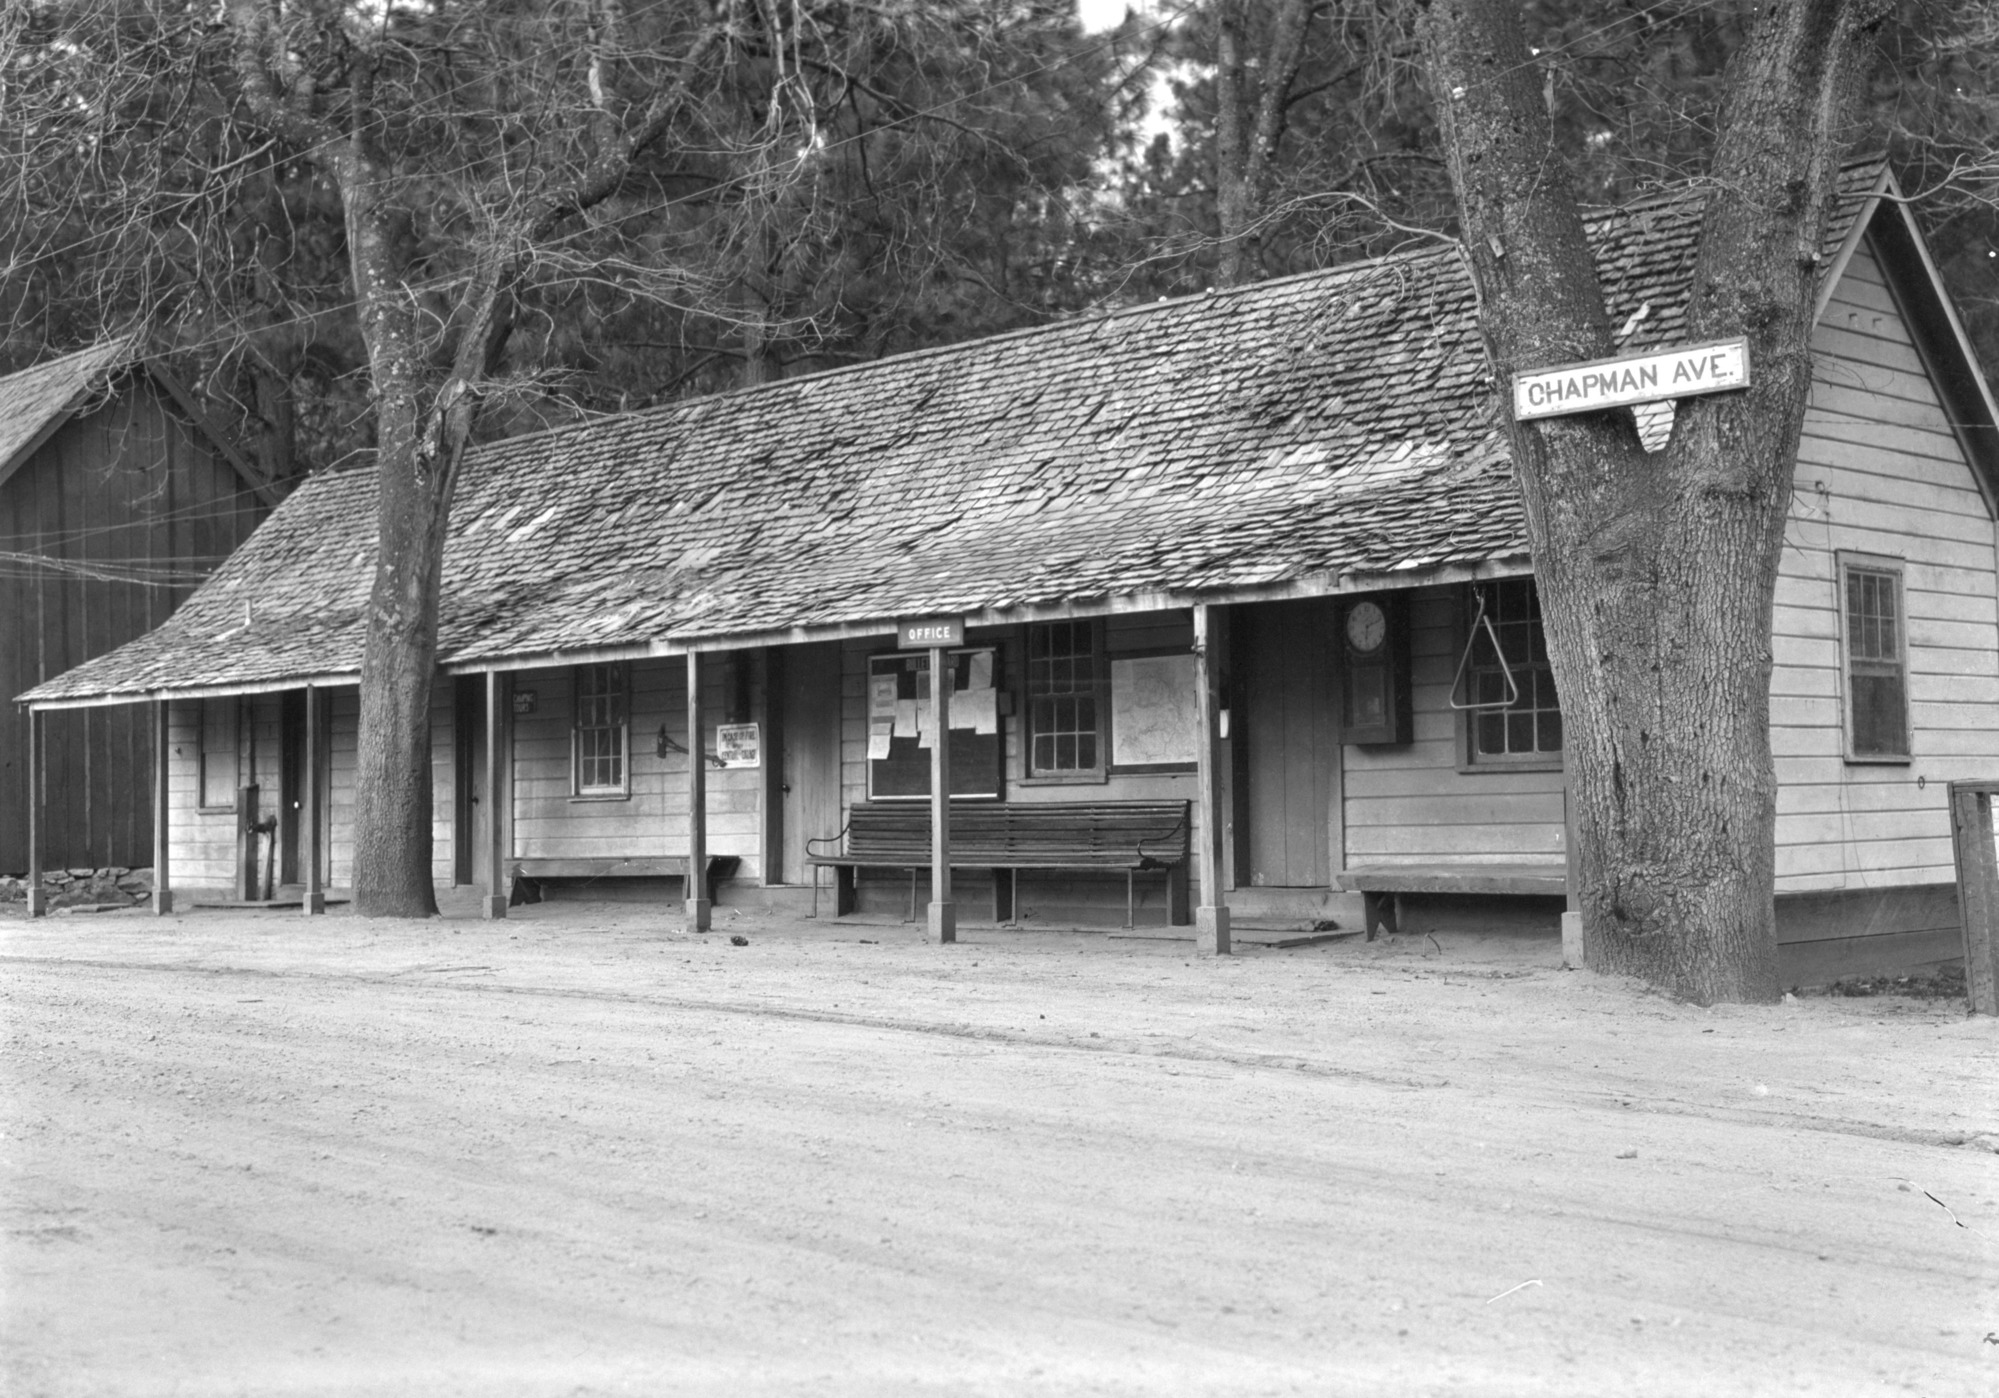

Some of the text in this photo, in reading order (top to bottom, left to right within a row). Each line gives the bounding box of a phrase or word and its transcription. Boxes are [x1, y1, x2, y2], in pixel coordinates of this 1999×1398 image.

[1528, 353, 1734, 406] CHAPMAN AVE.
[908, 626, 951, 640] OFFICE
